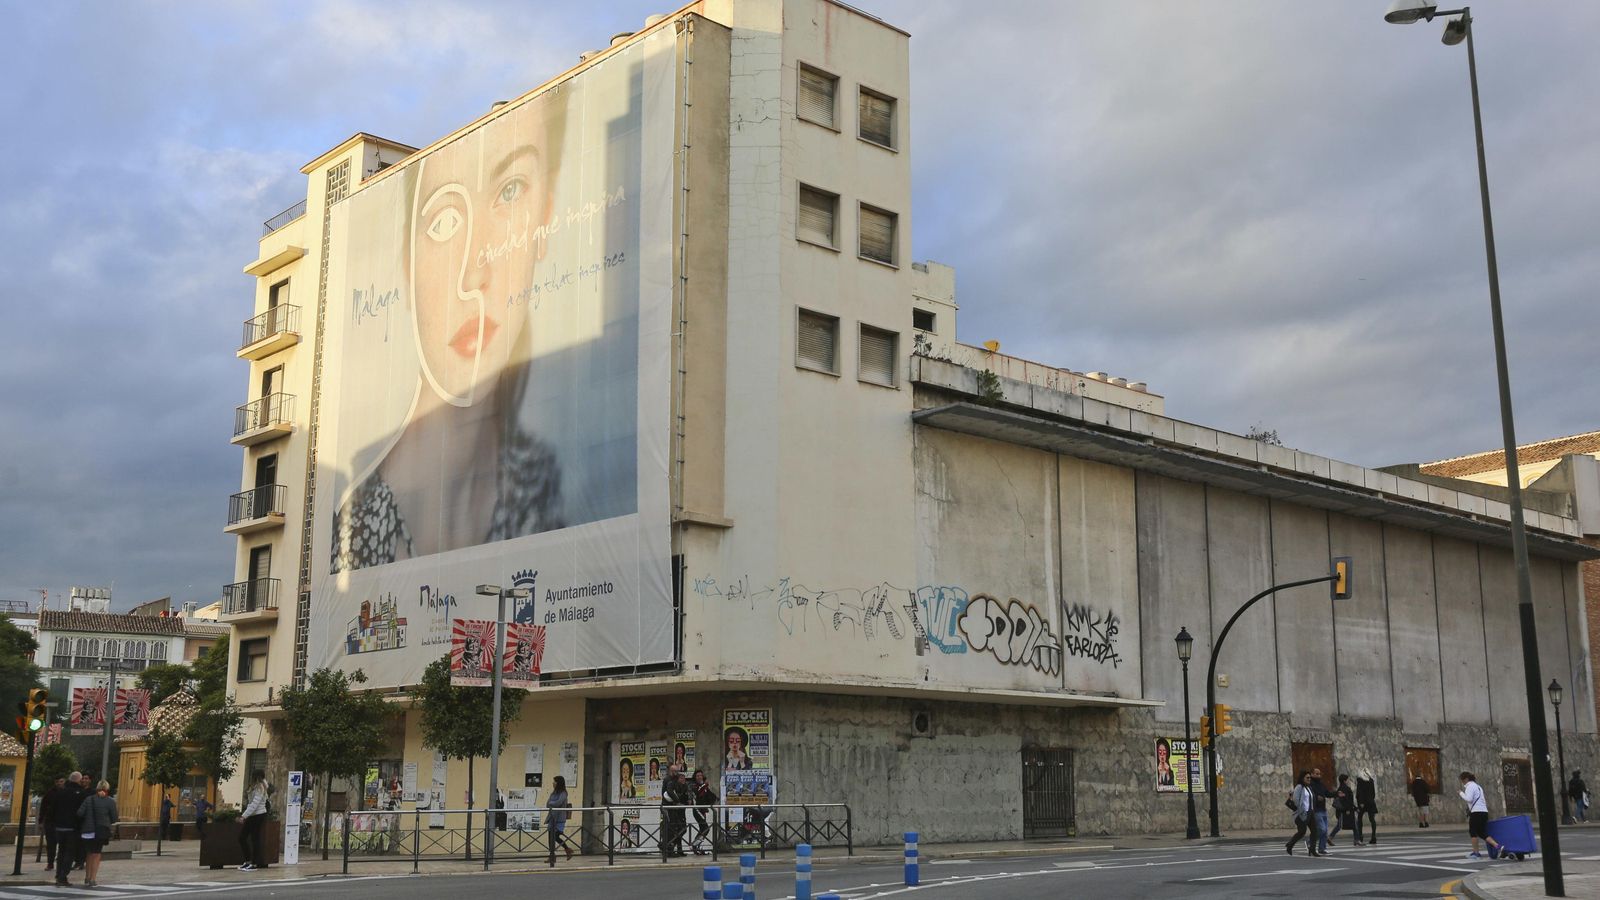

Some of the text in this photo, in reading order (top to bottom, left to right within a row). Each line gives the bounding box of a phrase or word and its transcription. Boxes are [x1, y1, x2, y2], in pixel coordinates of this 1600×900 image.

[476, 185, 627, 268] ciudad que inspira
[543, 263, 575, 293] that
[578, 251, 627, 294] inspires
[352, 284, 400, 342] Málaga
[419, 585, 458, 625] Málaga
[545, 581, 614, 605] Ayuntamiento
[544, 606, 595, 624] de Málaga
[726, 711, 769, 721] STOCK!
[621, 743, 645, 753] STOCK!
[1172, 741, 1199, 751] STOK!
